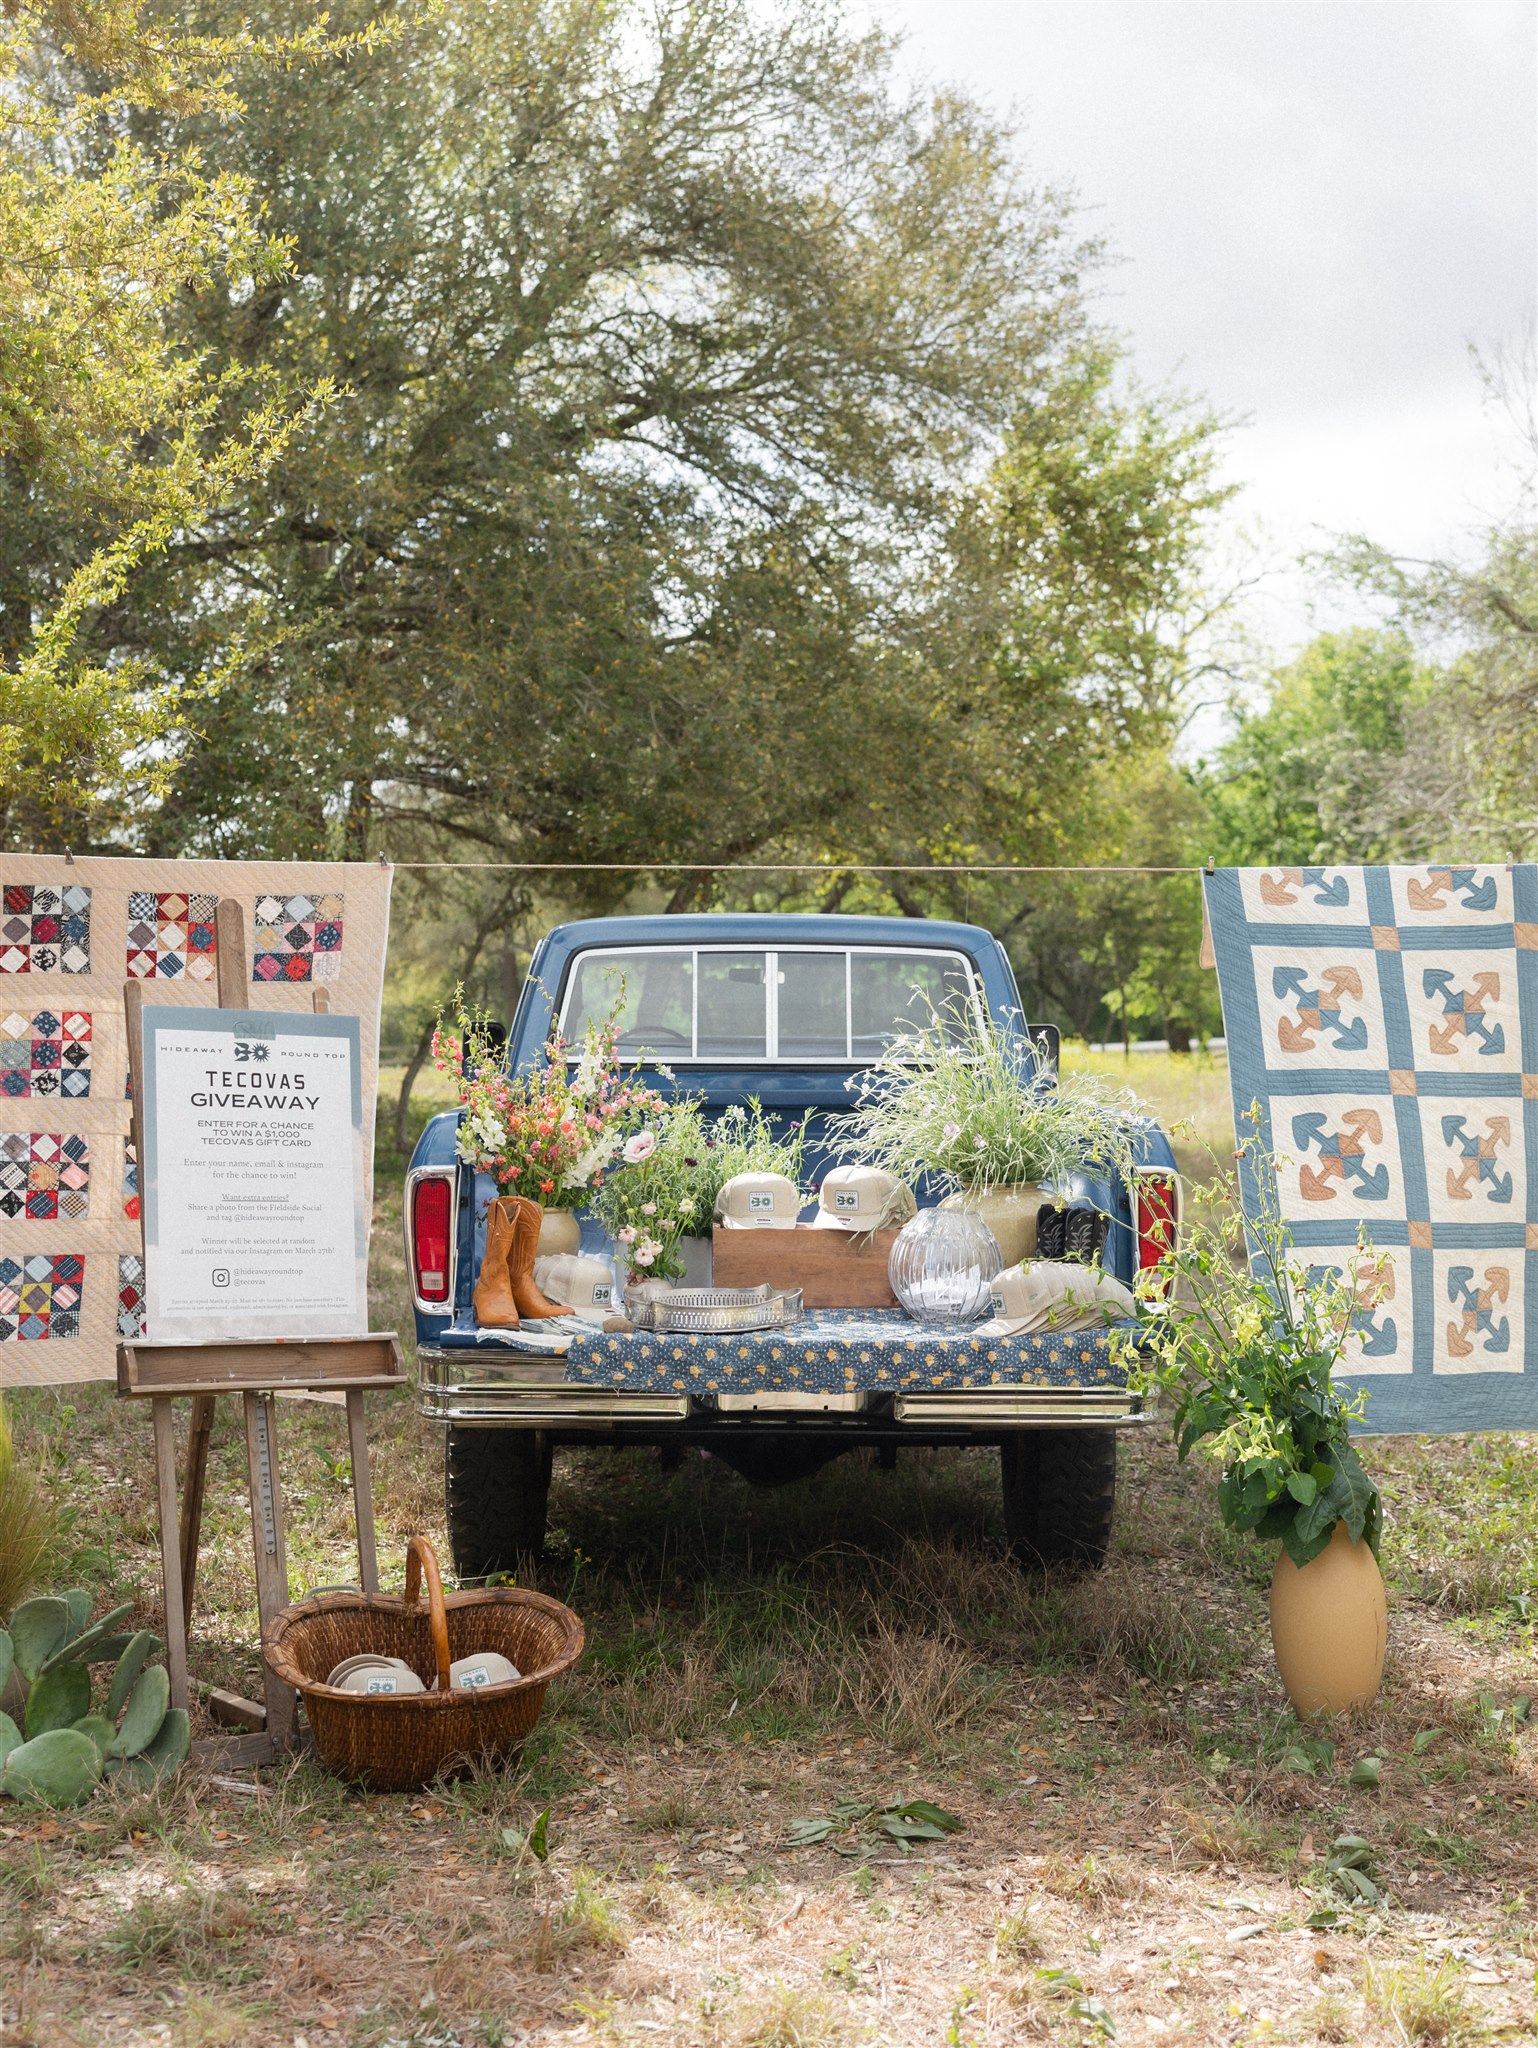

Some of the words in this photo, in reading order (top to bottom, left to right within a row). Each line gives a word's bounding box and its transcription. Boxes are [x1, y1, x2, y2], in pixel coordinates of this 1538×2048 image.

[160, 1046, 223, 1054] HIDEAWAY
[206, 1071, 305, 1089] TECOVAS
[191, 1093, 320, 1110] GIVEAWAY
[197, 1120, 234, 1128] ENTER
[270, 1122, 314, 1130] CHANCE
[265, 1130, 300, 1138] $1,000
[208, 1161, 226, 1169] your
[228, 1160, 253, 1168] name,
[254, 1160, 275, 1168] email
[286, 1161, 324, 1169] instagram
[212, 1171, 224, 1179] for
[215, 1204, 236, 1212] photo
[234, 1214, 304, 1223] @hideawayroundtop
[249, 1248, 283, 1256] Instagram
[233, 1268, 303, 1276] @hideawayroundtop
[233, 1278, 266, 1286] @tecovas
